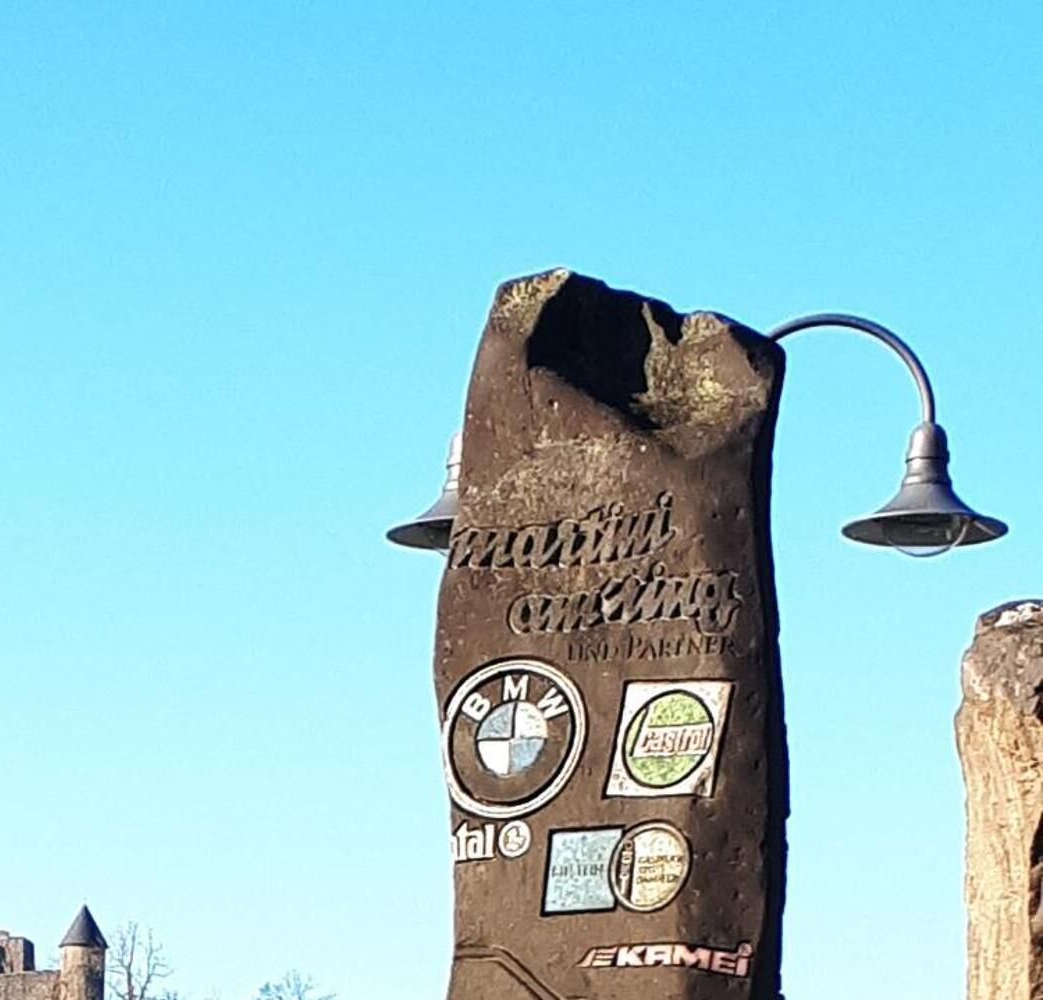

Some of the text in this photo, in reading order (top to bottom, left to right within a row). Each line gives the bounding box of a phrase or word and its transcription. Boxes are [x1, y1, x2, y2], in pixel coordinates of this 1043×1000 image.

[451, 491, 677, 569] martini
[627, 633, 735, 661] PARTNER
[461, 673, 569, 721] BMW
[641, 727, 712, 754] Castrol
